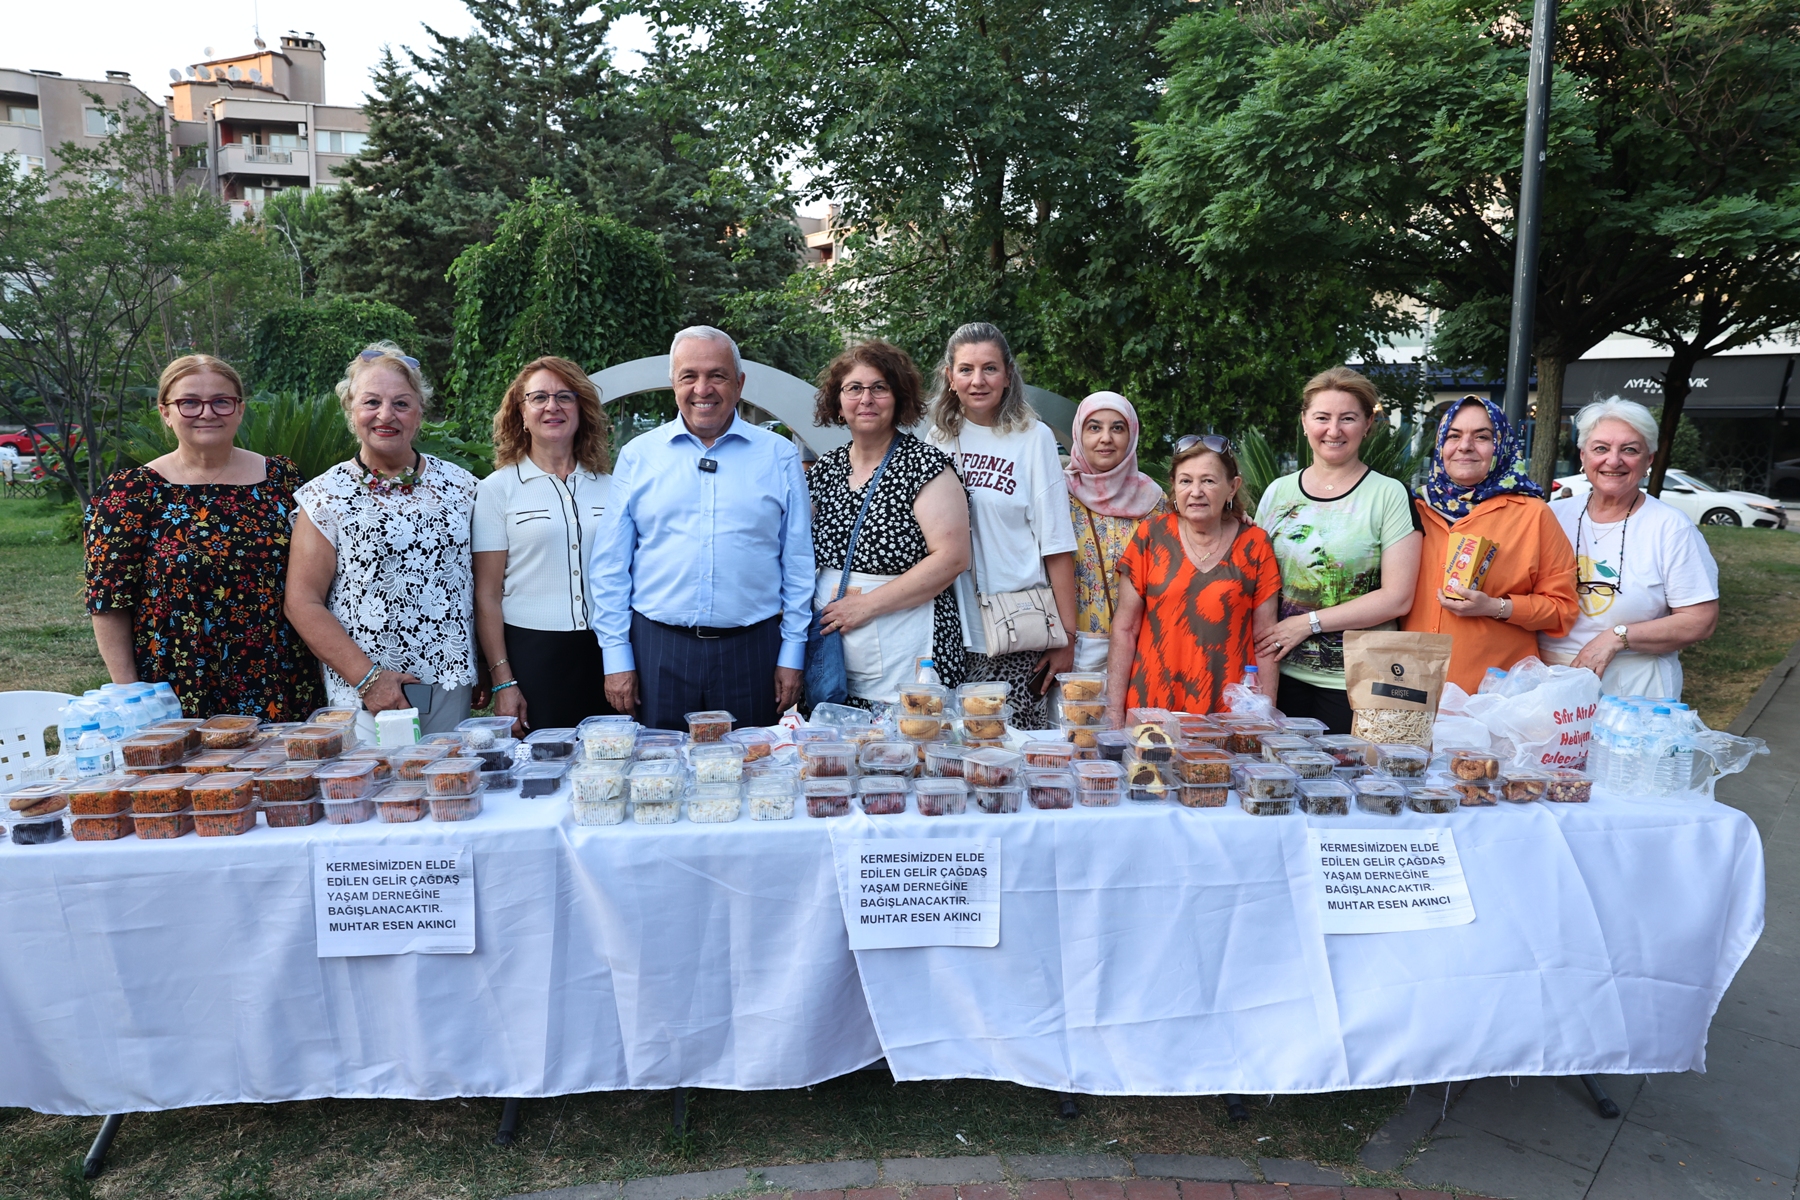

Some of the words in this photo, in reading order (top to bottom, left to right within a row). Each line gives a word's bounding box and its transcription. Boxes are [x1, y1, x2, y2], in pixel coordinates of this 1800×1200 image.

[963, 470, 1016, 496] NGELES
[1456, 538, 1478, 571] CORN
[1391, 688, 1409, 697] ERİŞTE
[1320, 842, 1407, 852] KERMESİMİZDEN
[1410, 843, 1440, 852] ELDE
[861, 852, 952, 864] KERMESİMİZDEN
[956, 853, 984, 862] ELDE
[1321, 856, 1360, 866] EDİLEN
[1363, 856, 1395, 866] GELİR
[1398, 856, 1446, 868] ÇAĞDAŞ
[326, 860, 422, 872] KERMESİMİZDEN
[426, 860, 456, 870] ELDE
[861, 866, 900, 878] EDİLEN
[904, 866, 937, 877] GELİR
[940, 866, 987, 878] ÇAĞDAŞ
[327, 876, 368, 886] EDİLEN
[372, 874, 407, 886] GELİR
[410, 874, 460, 887] ÇAĞDAŞ
[1323, 871, 1361, 882] YAŞAM
[1365, 870, 1429, 880] DERNEĞİNE
[861, 884, 900, 895] YAŞAM
[904, 880, 968, 892] DERNEĞİNE
[1325, 883, 1434, 896] BAĞIŞLANACAKTIR.
[327, 892, 368, 903] YAŞAM
[372, 889, 440, 900] DERNEĞİNE
[861, 896, 970, 909] BAĞIŞLANACAKTIR.
[1328, 901, 1375, 910] MUHTAR
[1378, 900, 1408, 909] ESEN
[1411, 896, 1450, 907] AKINCI
[328, 904, 443, 917] BAĞIŞLANACAKTIR.
[861, 914, 907, 924] MUHTAR
[911, 913, 940, 922] ESEN
[943, 913, 981, 922] AKINCI
[329, 922, 379, 932] MUHTAR
[383, 921, 413, 930] ESEN
[417, 920, 456, 929] AKINCI
